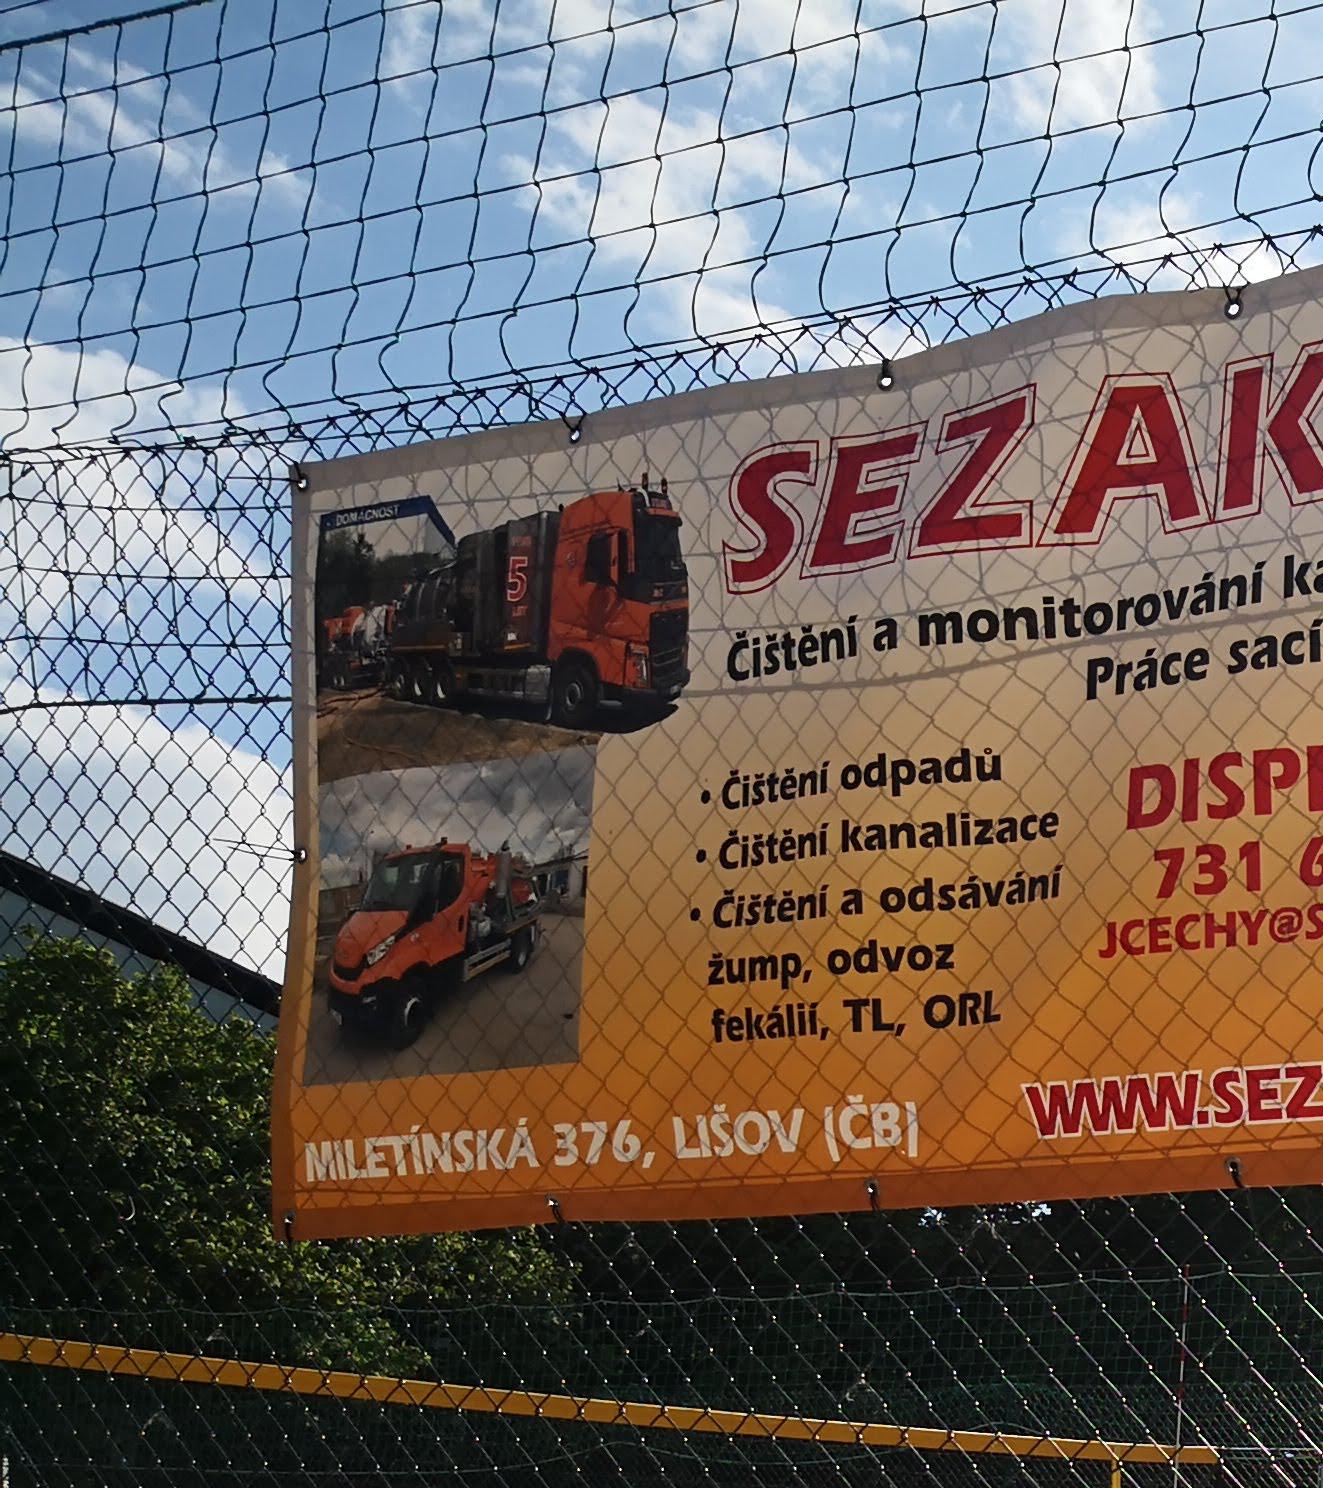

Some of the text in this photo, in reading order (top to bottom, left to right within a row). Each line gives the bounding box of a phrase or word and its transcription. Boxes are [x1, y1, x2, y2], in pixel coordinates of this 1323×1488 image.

[506, 556, 528, 602] 5
[727, 615, 858, 682] Čištění
[873, 616, 897, 651] a
[919, 561, 1264, 646] monitorování
[1086, 648, 1209, 700] Práce
[722, 746, 1001, 810] Čištění odpadů
[719, 811, 1059, 870] Čištění kanalizace
[713, 865, 1062, 928] Čištění a odsávání
[1154, 842, 1262, 898] 731
[707, 936, 955, 990] žump, odvoz
[712, 991, 1001, 1043] fekálií, TL, ORL
[304, 1094, 918, 1183] MILETÍNSKÁ 376, LIŠOV (ČB)
